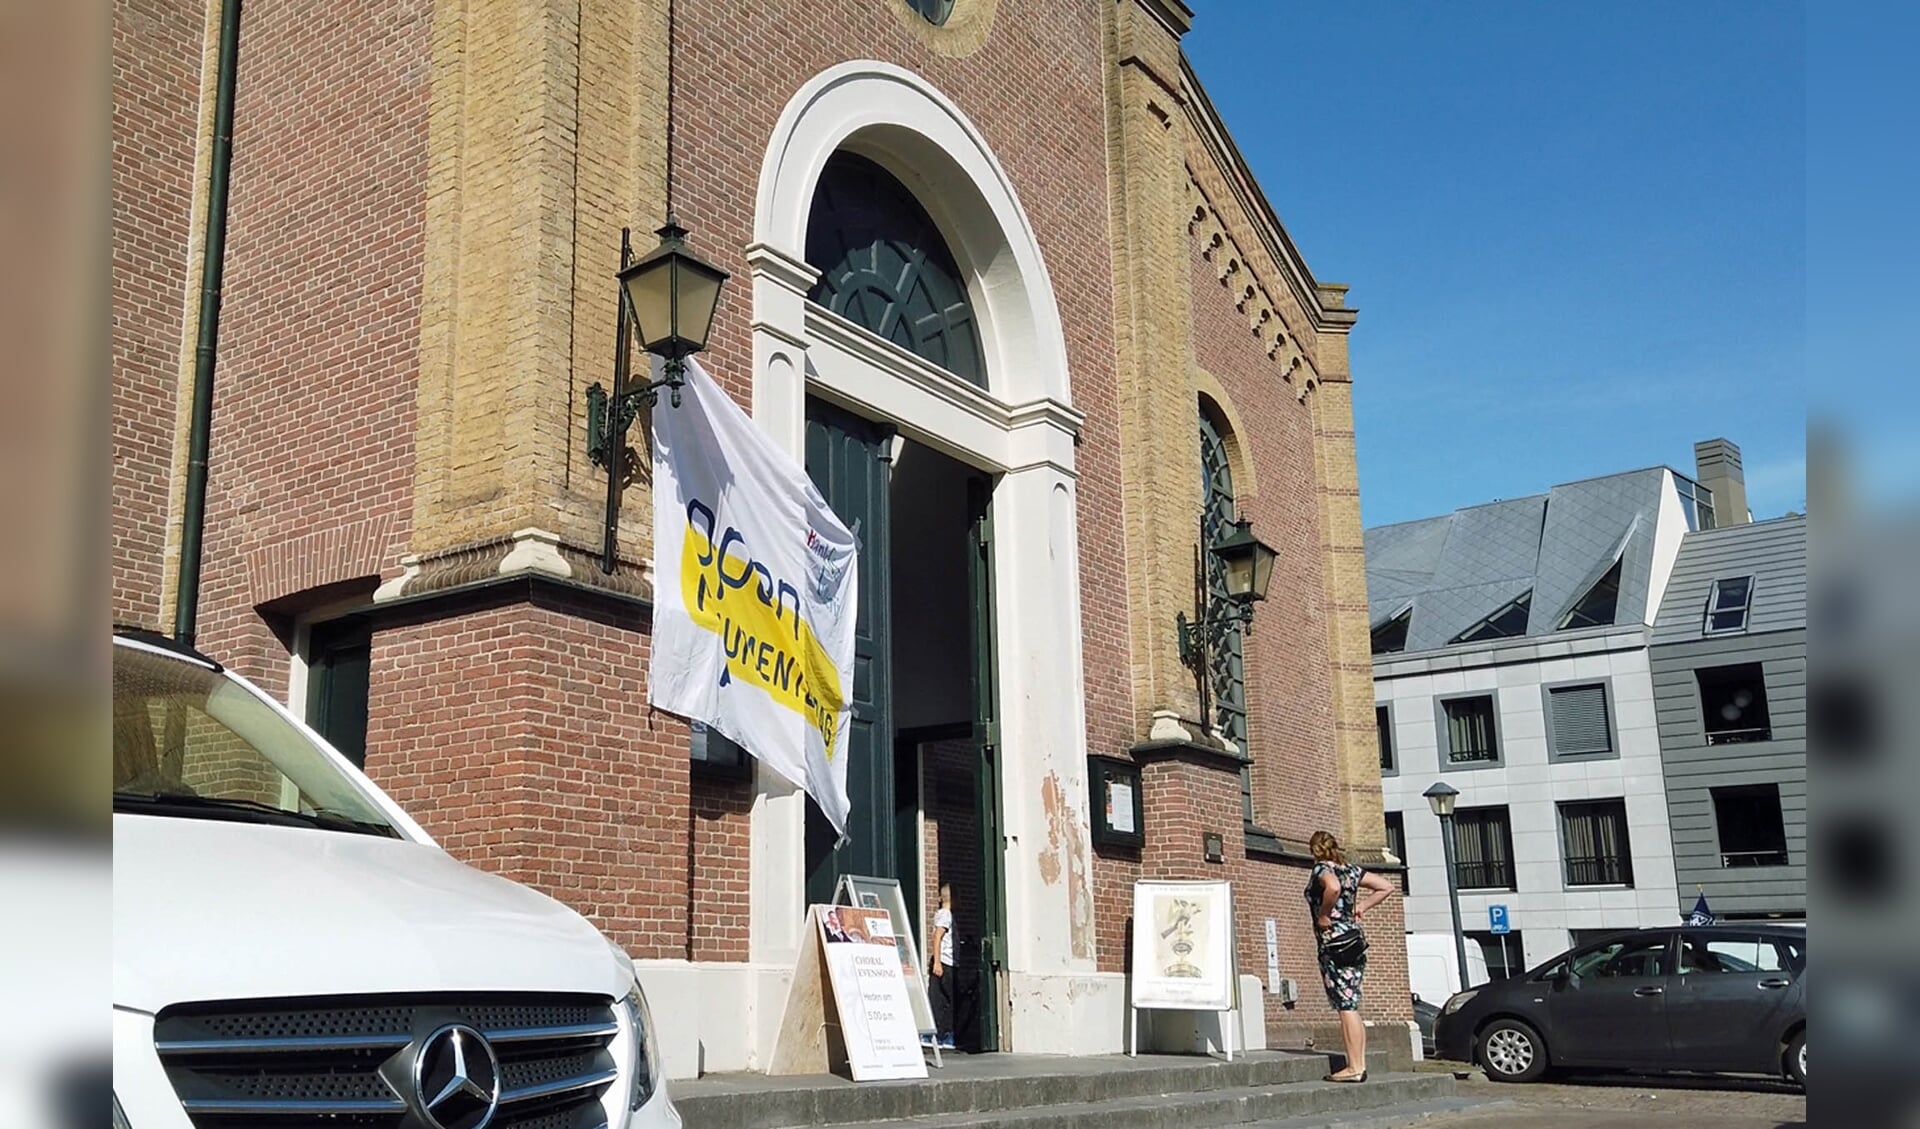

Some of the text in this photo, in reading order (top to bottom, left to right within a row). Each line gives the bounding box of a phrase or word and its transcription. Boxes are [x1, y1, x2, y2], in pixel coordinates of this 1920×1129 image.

[1492, 908, 1503, 923] P
[855, 956, 884, 966] CHORAL
[858, 968, 896, 978] EVENSONG
